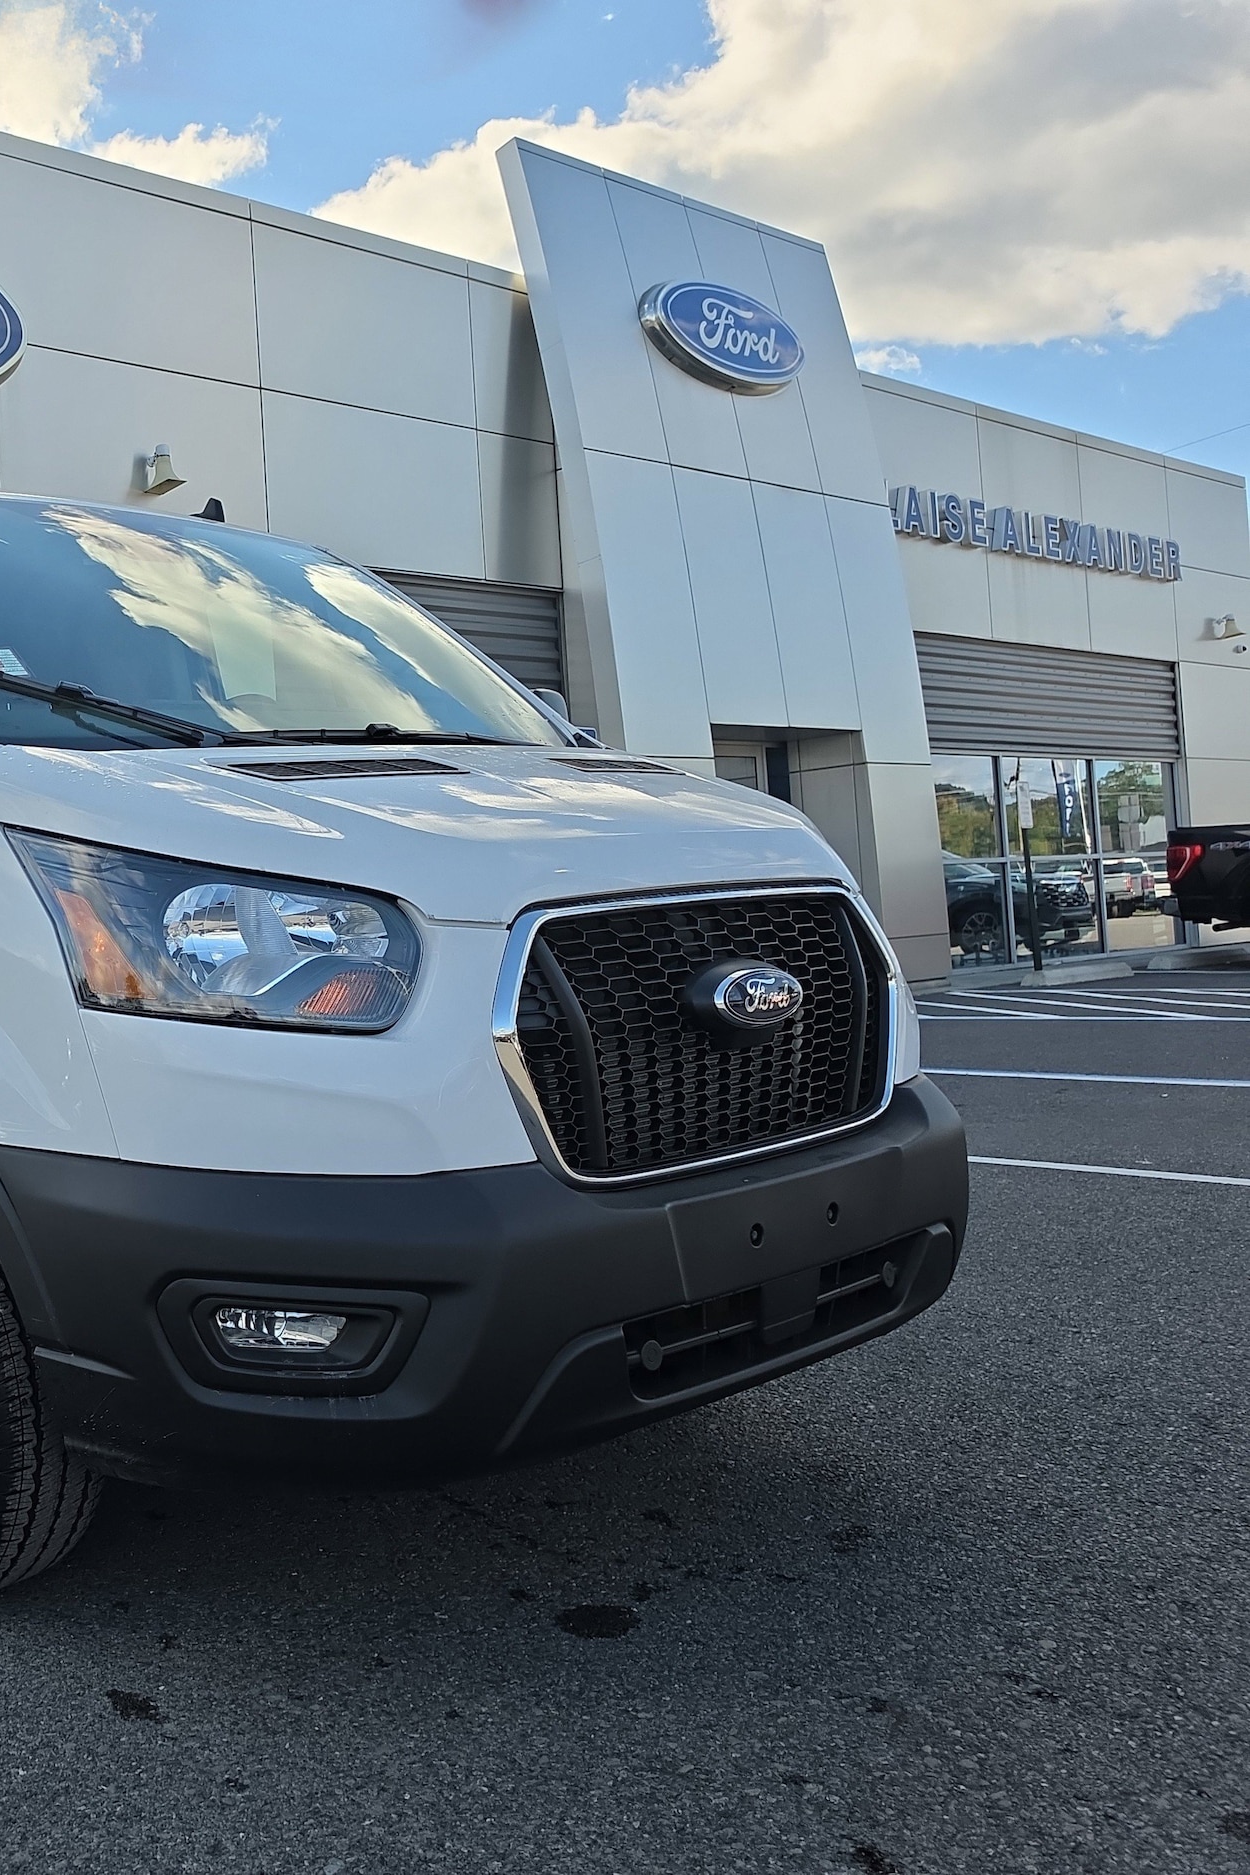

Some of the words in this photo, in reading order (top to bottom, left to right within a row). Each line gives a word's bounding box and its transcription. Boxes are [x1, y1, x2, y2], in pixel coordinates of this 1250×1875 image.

[699, 297, 780, 365] Ford
[892, 485, 989, 547] AISE
[1001, 505, 1183, 581] ALEXANDER
[745, 977, 791, 1013] Ford
